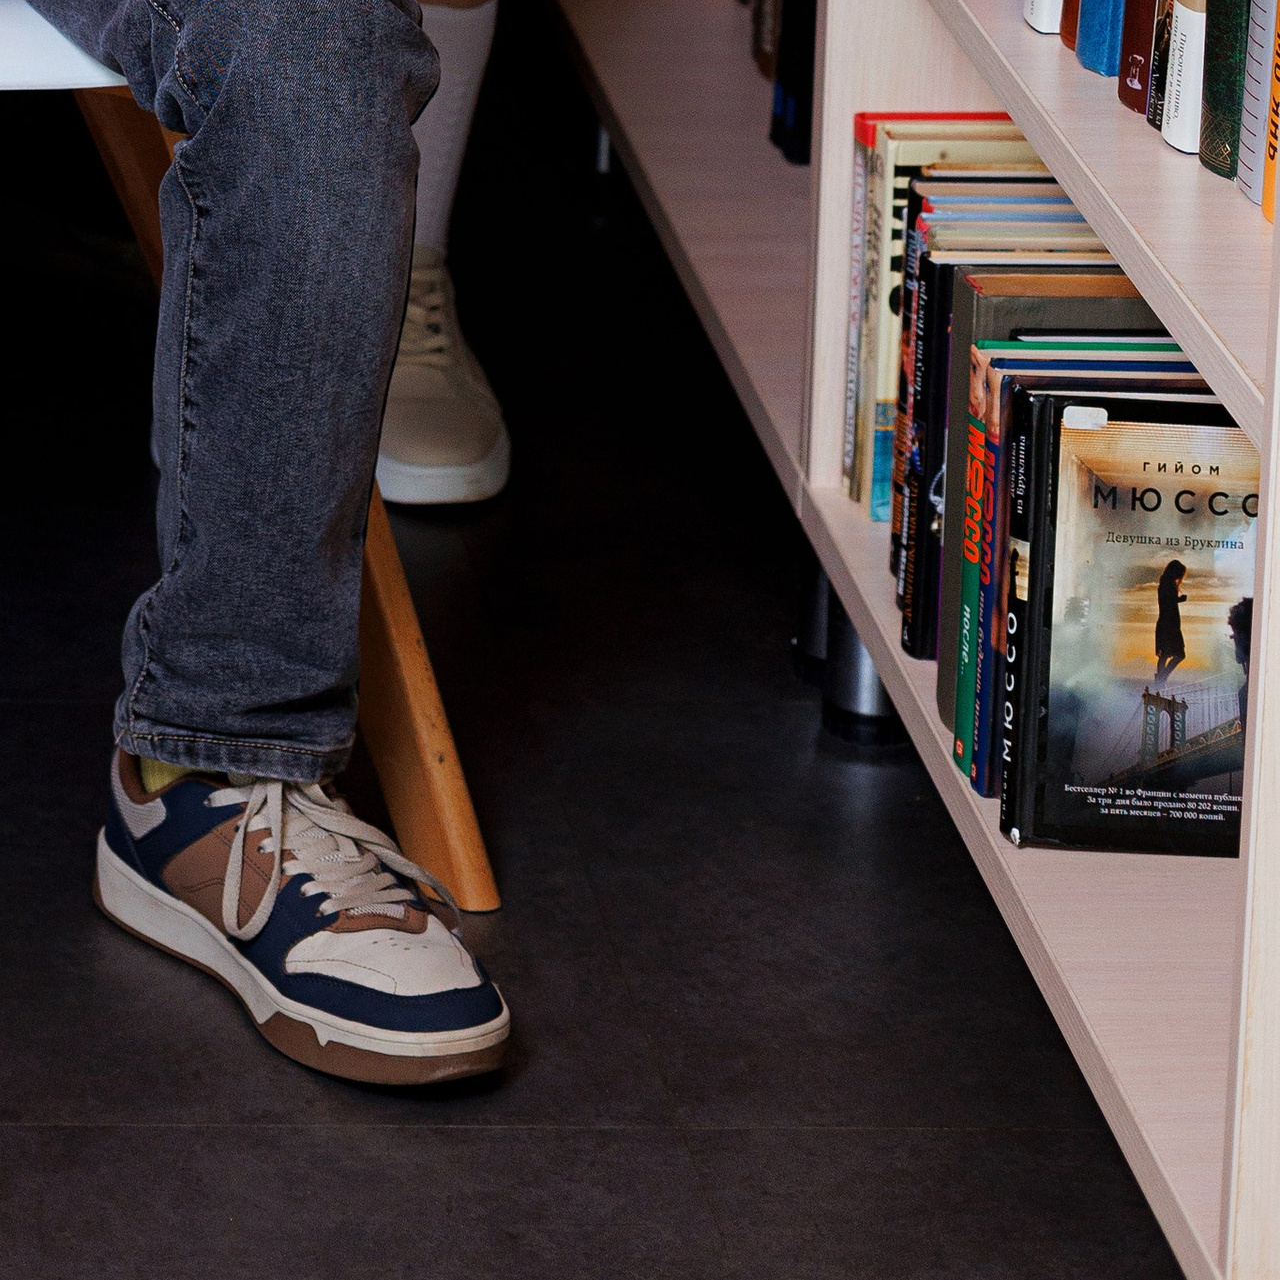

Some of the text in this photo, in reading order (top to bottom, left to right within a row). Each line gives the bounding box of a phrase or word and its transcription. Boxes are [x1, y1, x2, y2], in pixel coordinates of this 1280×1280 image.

[1178, 33, 1187, 72] Пироги
[1173, 87, 1183, 121] пиво,
[1016, 435, 1026, 499] Бруклина
[1143, 461, 1220, 475] ГИЙОМ
[964, 425, 986, 563] МЮССО
[1093, 485, 1259, 517] МЮССО
[1106, 531, 1244, 550] Девушка из Бруклина
[1003, 612, 1018, 762] МЮССО
[1064, 784, 1107, 795] Бестселлер
[1136, 788, 1172, 798] Франции
[1178, 792, 1212, 800] момента
[1097, 797, 1111, 805] три
[1131, 798, 1152, 807] было
[1154, 801, 1186, 810] продано
[1187, 801, 1197, 809] 80
[1198, 802, 1211, 810] 202
[1169, 810, 1182, 818] 700
